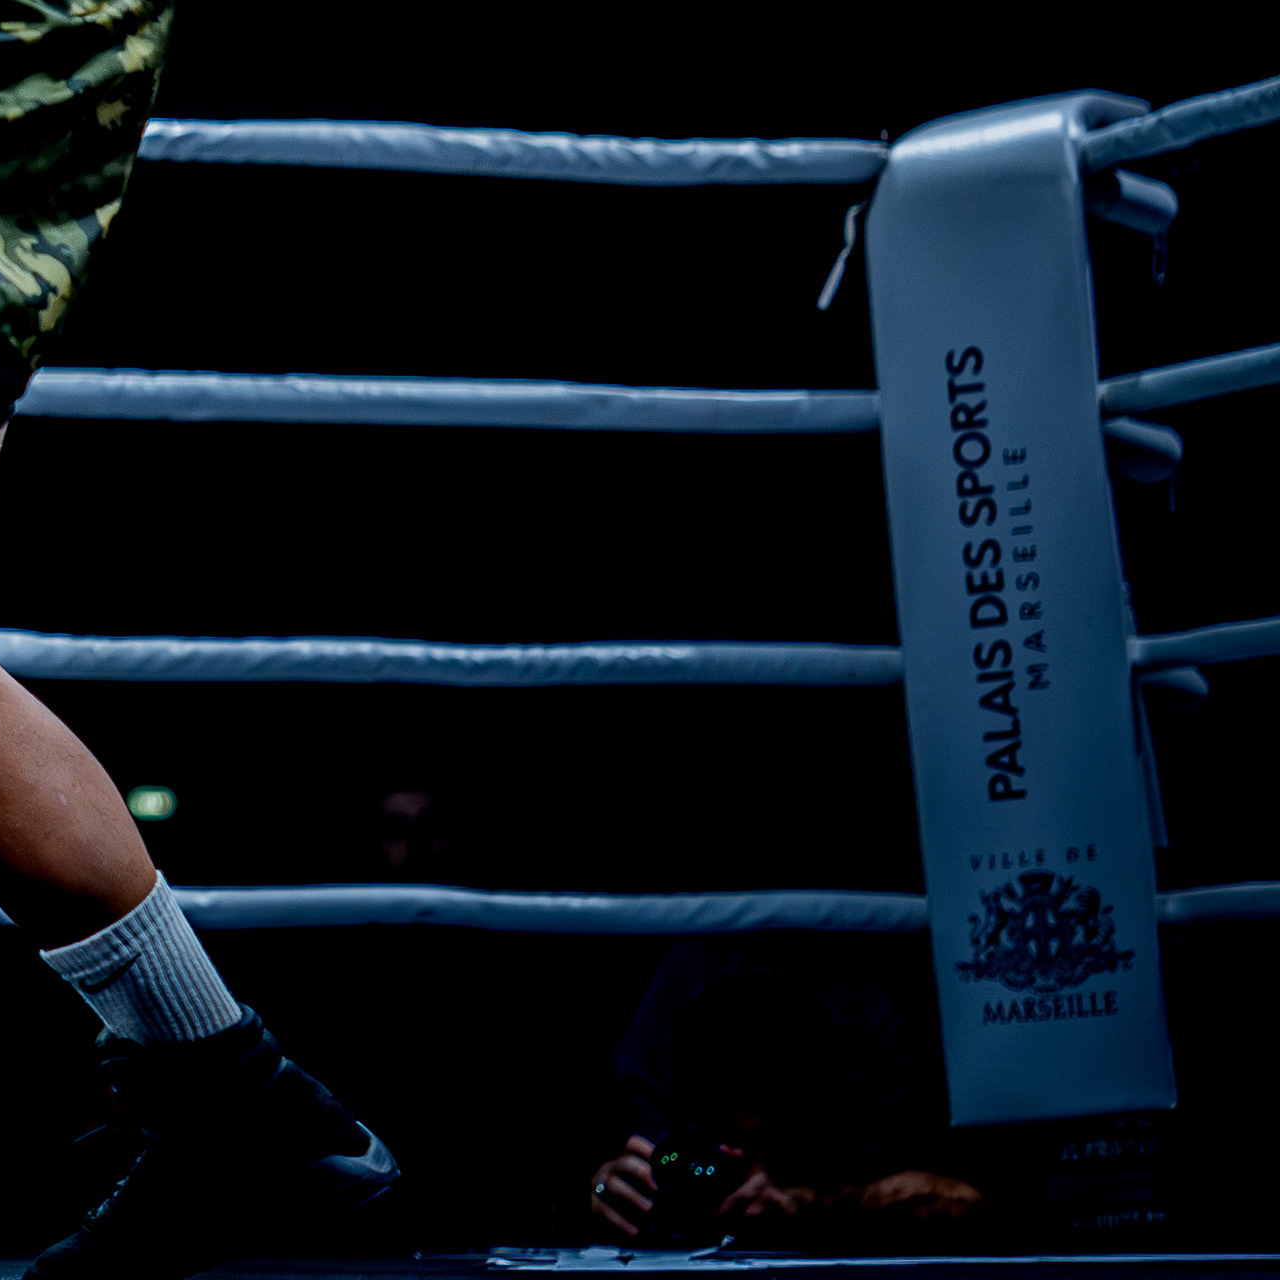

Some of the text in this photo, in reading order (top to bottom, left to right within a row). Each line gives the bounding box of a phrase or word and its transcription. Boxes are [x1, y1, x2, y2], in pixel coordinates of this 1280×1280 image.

[945, 346, 1028, 803] PALAIS DES SPORTS
[1002, 447, 1051, 691] MARSEILLE
[970, 845, 1097, 871] VILLE DE
[983, 991, 1118, 1026] MARSEILLE
